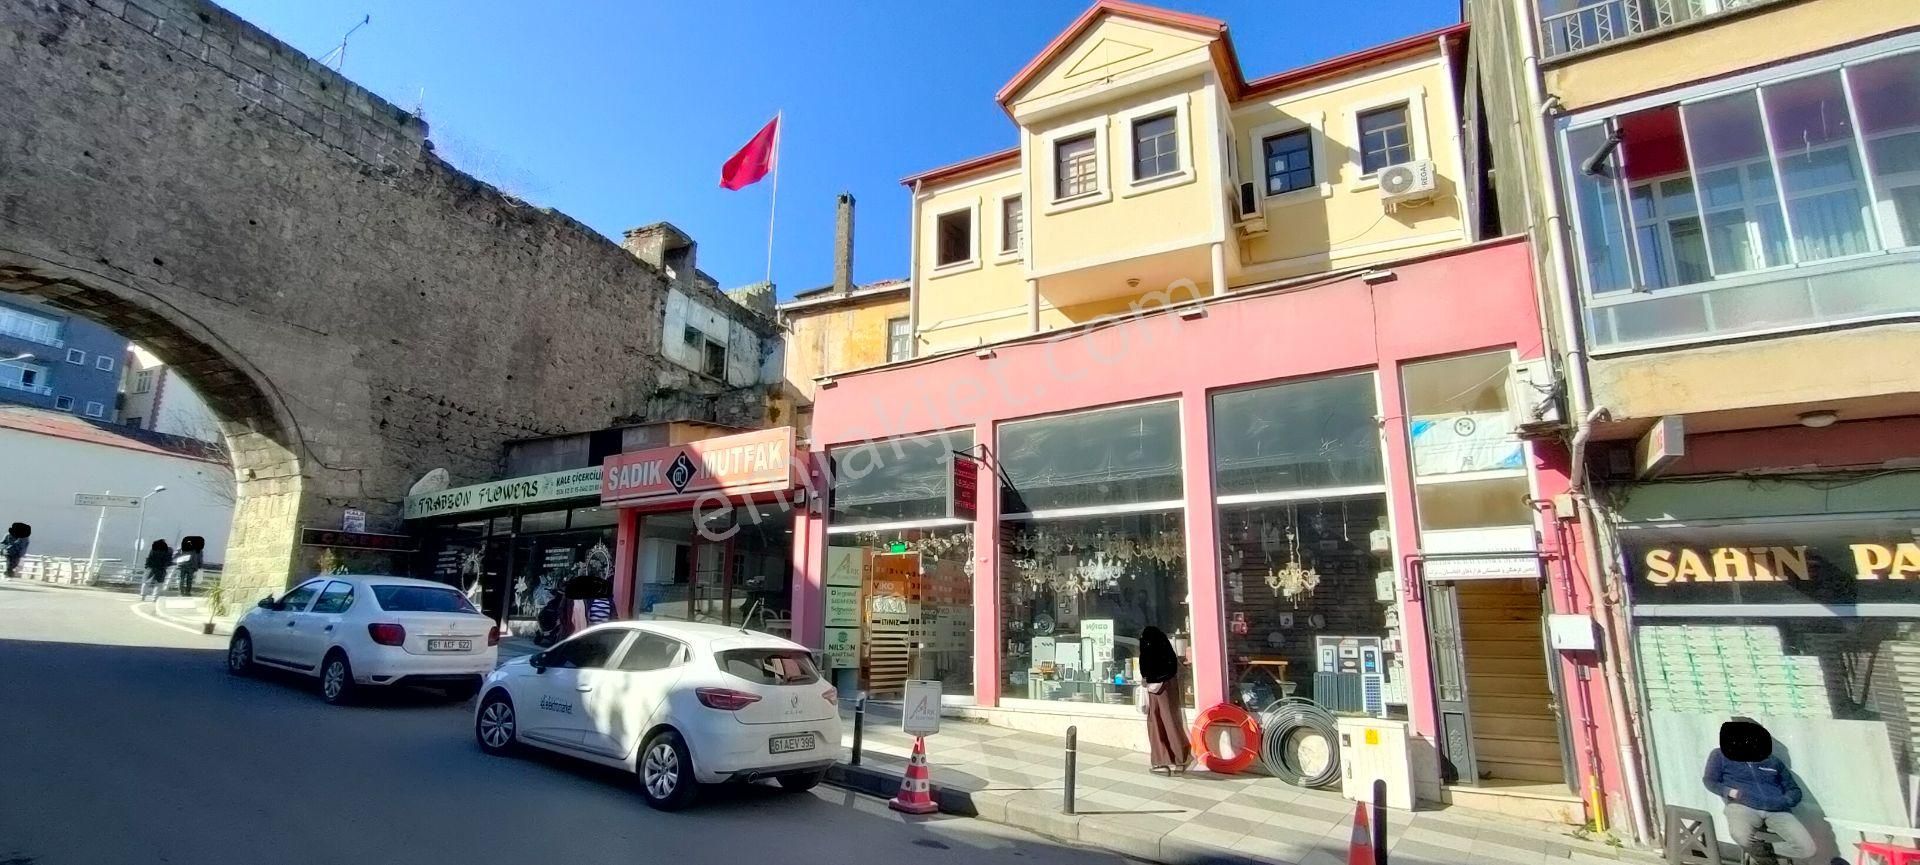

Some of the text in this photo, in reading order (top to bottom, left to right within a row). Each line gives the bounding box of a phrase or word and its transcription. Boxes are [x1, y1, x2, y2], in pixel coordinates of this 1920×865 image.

[607, 459, 663, 491] SADIK
[700, 439, 786, 480] MUTFAK
[556, 475, 571, 487] KALE
[418, 490, 472, 515] TRABZON
[478, 480, 539, 505] FLOWERS
[774, 740, 783, 751] 61
[784, 739, 800, 750] AEV
